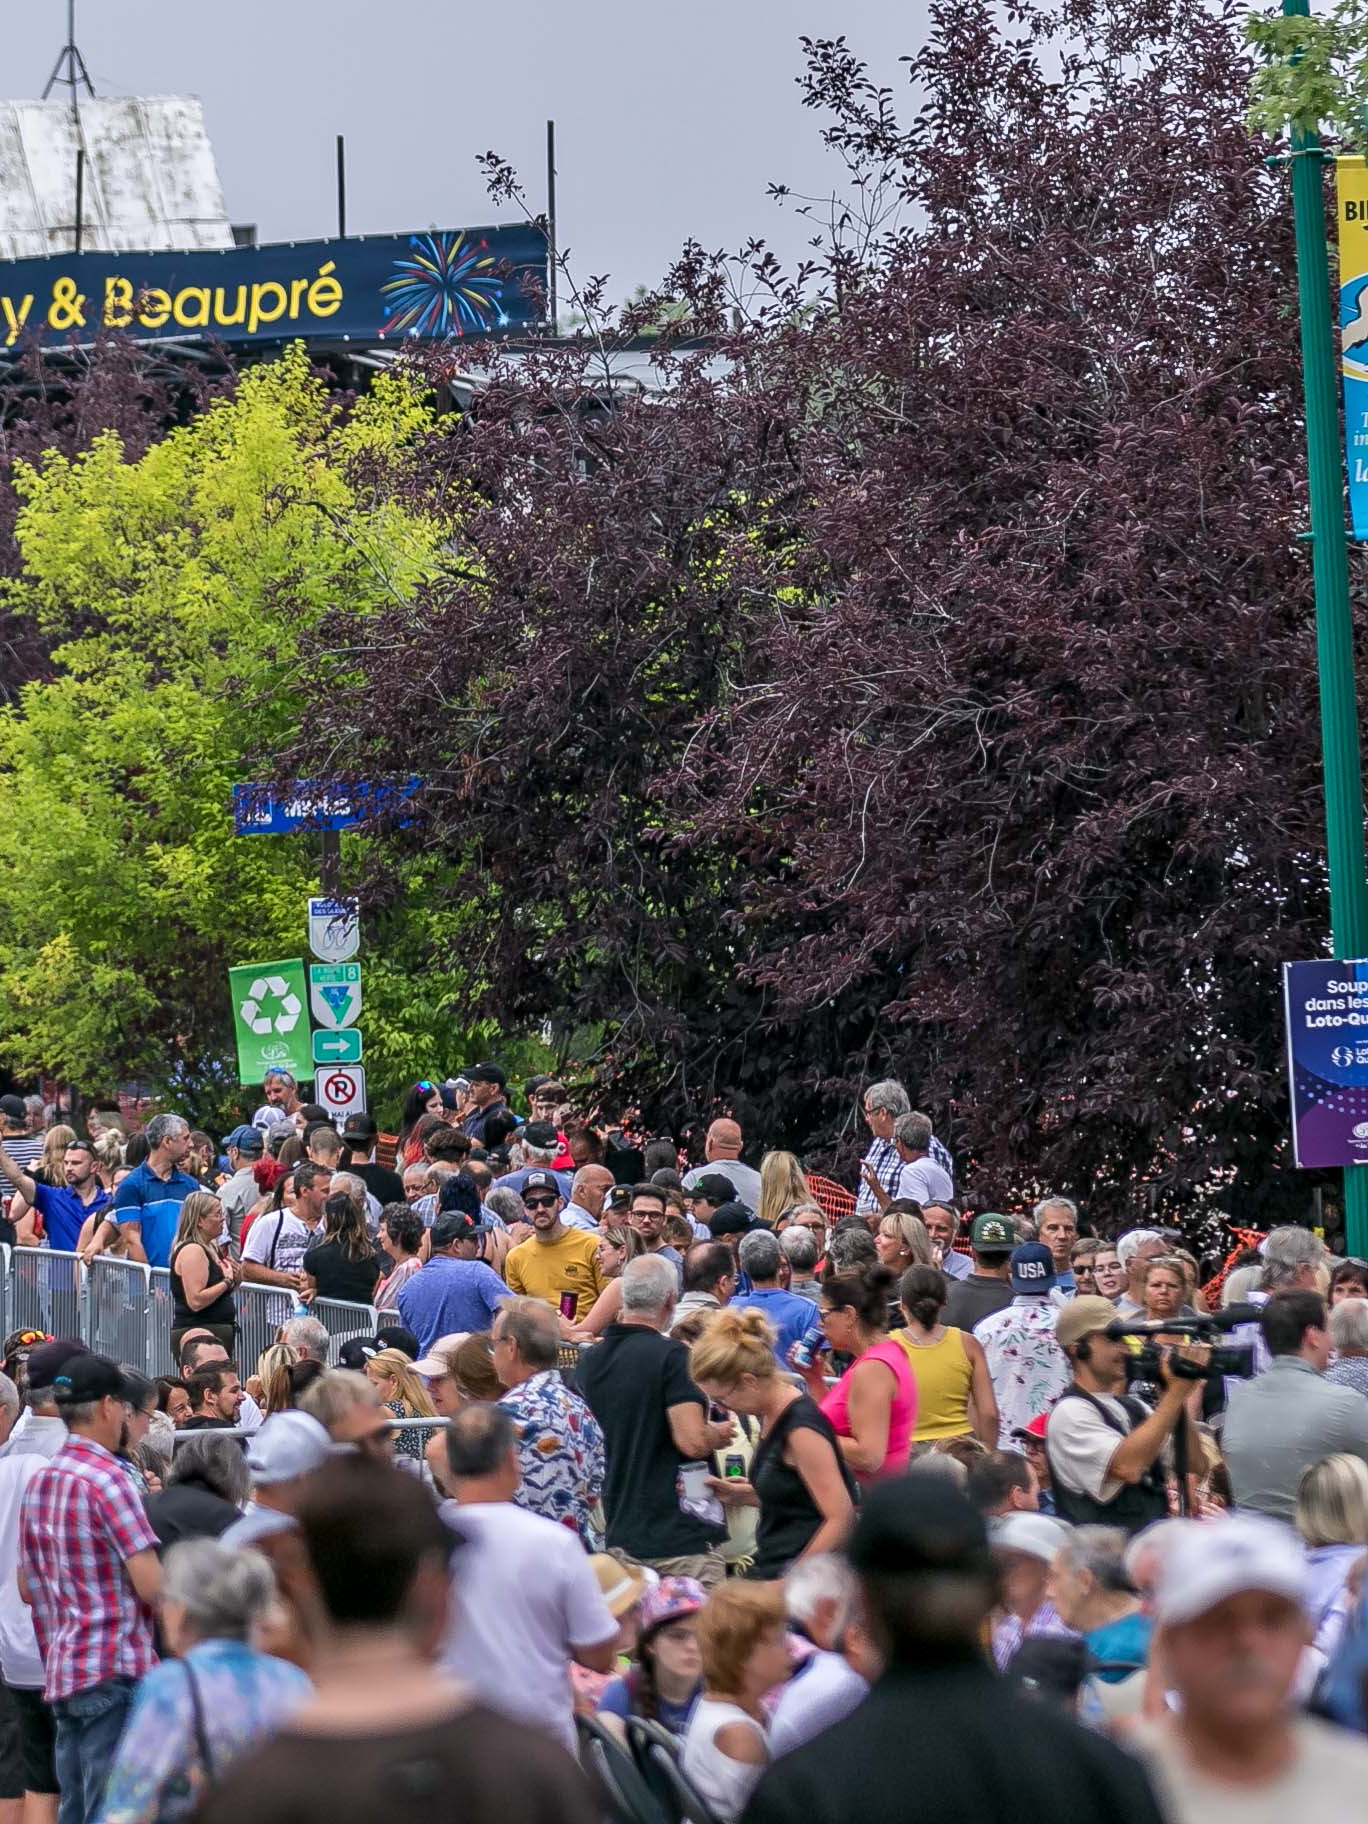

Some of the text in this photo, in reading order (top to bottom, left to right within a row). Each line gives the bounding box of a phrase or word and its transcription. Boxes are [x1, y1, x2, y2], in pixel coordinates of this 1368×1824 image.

[1345, 200, 1368, 221] BI
[47, 276, 86, 331] &
[104, 260, 343, 334] Beaupré
[347, 966, 357, 980] 8
[1305, 997, 1346, 1011] dans
[1017, 1261, 1046, 1279] USA
